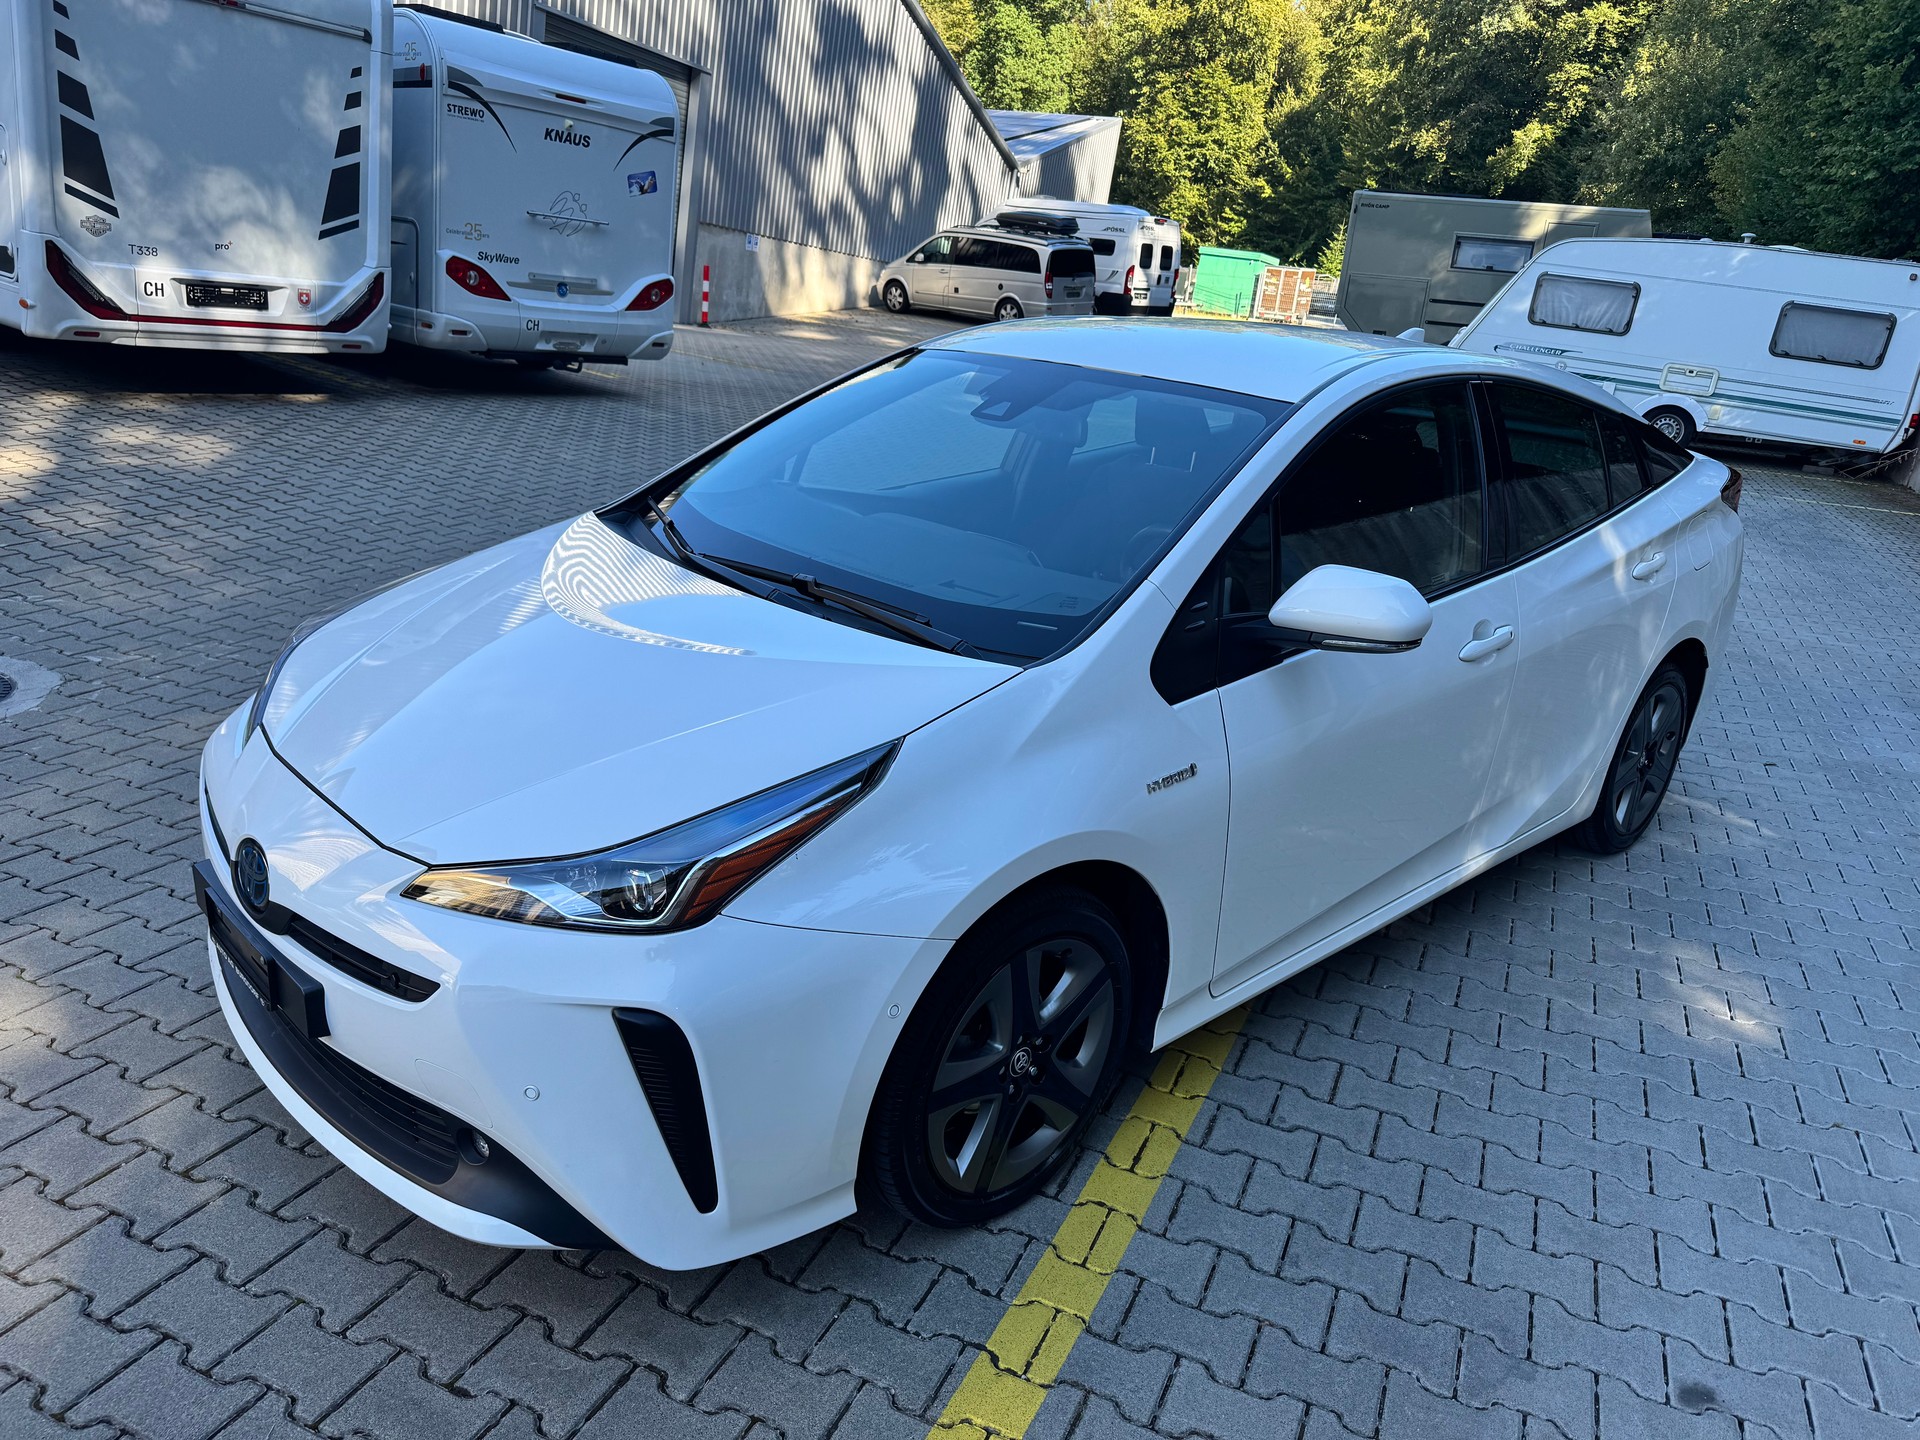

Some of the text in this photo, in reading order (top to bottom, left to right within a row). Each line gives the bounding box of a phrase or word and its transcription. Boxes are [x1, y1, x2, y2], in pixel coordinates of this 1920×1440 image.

[446, 103, 485, 119] STREWO
[544, 127, 591, 148] KNAUS
[464, 222, 483, 241] 25
[128, 244, 159, 257] T338
[477, 251, 520, 265] SkyWave
[143, 281, 165, 297] CH
[525, 319, 540, 331] CH
[1509, 343, 1562, 356] CHALLENGER
